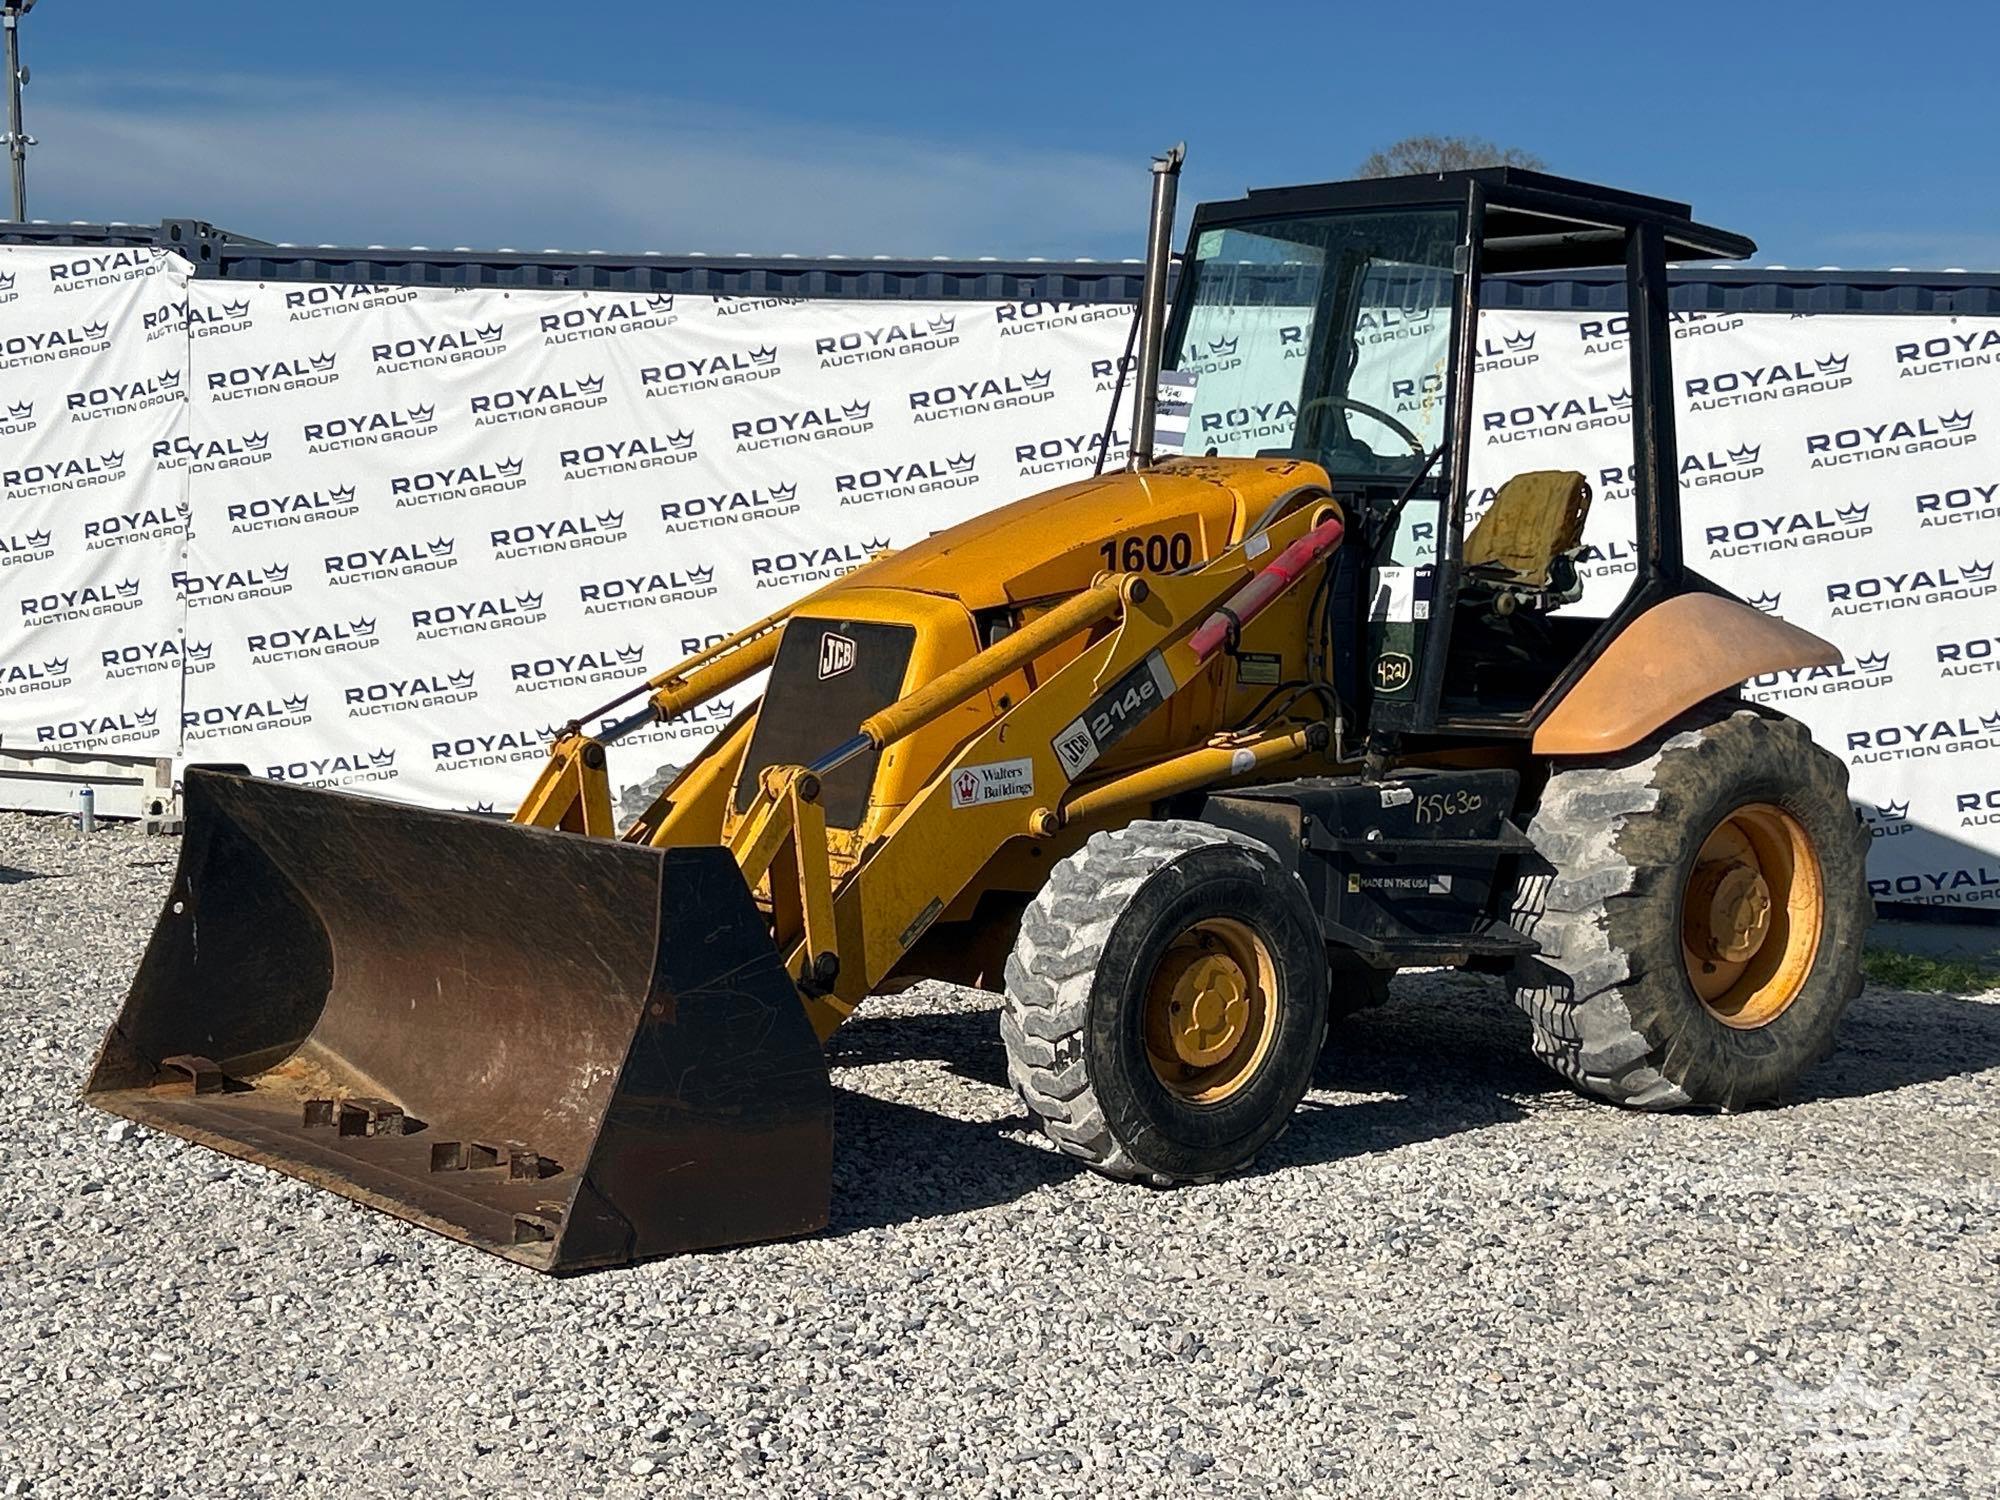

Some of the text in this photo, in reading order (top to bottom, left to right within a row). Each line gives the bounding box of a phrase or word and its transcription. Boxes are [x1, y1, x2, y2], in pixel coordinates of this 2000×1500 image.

[50, 249, 149, 281] ROYAL
[53, 273, 120, 294] AUCTION
[289, 291, 418, 322] AUCTION GROUP
[540, 301, 646, 332] ROYAL
[198, 320, 253, 338] GROUP
[545, 316, 677, 345] AUCTION GROUP
[816, 323, 927, 355] ROYAL
[1000, 315, 1077, 337] AUCTION
[1369, 324, 1435, 345] GROUP
[1675, 319, 1744, 339] GROUP
[0, 328, 83, 357] OYAL
[0, 341, 111, 370] UCTION GROUP
[372, 331, 477, 362] ROYAL
[821, 337, 959, 369] AUCTION GROUP
[1896, 330, 2000, 363] ROYA
[376, 345, 506, 375] AUCTION GROUP
[641, 353, 749, 385] ROYAL
[1475, 354, 1539, 373] GROUP
[1899, 353, 1991, 378] AUCTION
[208, 360, 309, 390] ROYAL
[212, 374, 339, 403] AUCTION GROUP
[646, 368, 780, 398] AUCTION GROUP
[1686, 362, 1815, 397] ROYAL
[67, 379, 158, 410] ROYAL
[72, 391, 185, 422] AUCTION GROUP
[471, 382, 577, 413] ROYAL
[909, 377, 1022, 409] ROYAL
[914, 391, 1054, 423] AUCTION GROUP
[1690, 377, 1852, 412] AUCTION GROUP
[304, 411, 408, 441] ROYAL
[475, 397, 607, 426] AUCTION GROUP
[732, 408, 842, 439] ROYAL
[1201, 400, 1297, 431] ROYA
[1483, 396, 1608, 431] ROYAL
[309, 426, 438, 454] AUCTION GROUP
[737, 422, 873, 453] AUCTION GROUP
[1205, 423, 1285, 446] AUCTION
[1487, 413, 1630, 445] AUCTION GROU
[1807, 418, 1938, 453] ROYAL
[156, 452, 272, 474] AUCION GROUP
[560, 437, 667, 467] ROYAL
[1811, 434, 1976, 468] AUCTION GROUP
[3, 458, 101, 487] ROYAL
[391, 465, 496, 495] ROYAL
[565, 452, 697, 480] AUCTION GROUP
[835, 461, 947, 492] ROYAL
[1019, 456, 1096, 477] AUCTION
[1695, 467, 1764, 487] GROUP
[7, 471, 125, 499] AUCTION GROUP
[396, 479, 526, 508] AUCTION GROUP
[841, 476, 979, 506] AUCTION GROUP
[228, 492, 329, 521] ROYAL
[661, 490, 768, 521] ROYAL
[666, 505, 800, 534] AUCTION GROUP
[85, 507, 173, 539] ROYAL
[232, 507, 359, 534] AUCTION GROUP
[491, 517, 596, 547] ROYAL
[1706, 511, 1835, 545] ROYAL
[86, 532, 150, 551] AUCTION
[495, 532, 627, 560] AUCTION GROUP
[1100, 532, 1192, 573] 1600
[1710, 527, 1872, 559] AUCTION GROUP
[2, 549, 55, 567] GROUP
[325, 544, 428, 573] ROYAL
[329, 559, 457, 586] AUCTION GROUP
[752, 544, 861, 575] ROYAL
[238, 584, 293, 601] GROUP
[580, 572, 687, 602] ROYAL
[756, 569, 830, 589] AUCTION
[1827, 569, 1959, 602] ROYAL
[21, 586, 115, 615] ROYAL
[24, 599, 142, 627] AUCTION GROUP
[412, 598, 516, 627] ROYAL
[585, 587, 717, 615] AUCTION GROUP
[1832, 585, 1997, 617] AUCTION GROUP
[248, 624, 350, 652] ROYAL
[417, 613, 546, 640] AUCTION GROUP
[253, 639, 379, 664] AUCTION GROUP
[511, 652, 616, 680] ROYAL
[823, 638, 853, 674] JCB
[105, 660, 171, 680] AUCTION
[515, 667, 647, 693] AUCTION GROUP
[1822, 675, 1893, 694] GROUP
[20, 677, 72, 695] GROUP
[345, 677, 448, 705] ROYAL
[182, 700, 283, 728] ROYAL
[349, 692, 478, 717] AUCTION GROUP
[1091, 680, 1155, 741] 214e
[37, 713, 135, 742] ROYAL
[111, 728, 160, 744] GROUP
[185, 714, 312, 741] AUCTION GROUP
[1847, 718, 1979, 750] ROYAL
[432, 731, 537, 759] ROYAL
[435, 746, 553, 772] AUCTION GROU
[1063, 734, 1090, 764] JCB
[1851, 738, 2000, 765] AUCTION GROU
[266, 754, 370, 780] ROYAL
[343, 769, 398, 786] GROUP
[981, 767, 1024, 781] Walters
[984, 783, 1033, 799] Buildings
[1361, 878, 1428, 888] MADE IN THE USA
[1867, 868, 1999, 897] ROYAL
